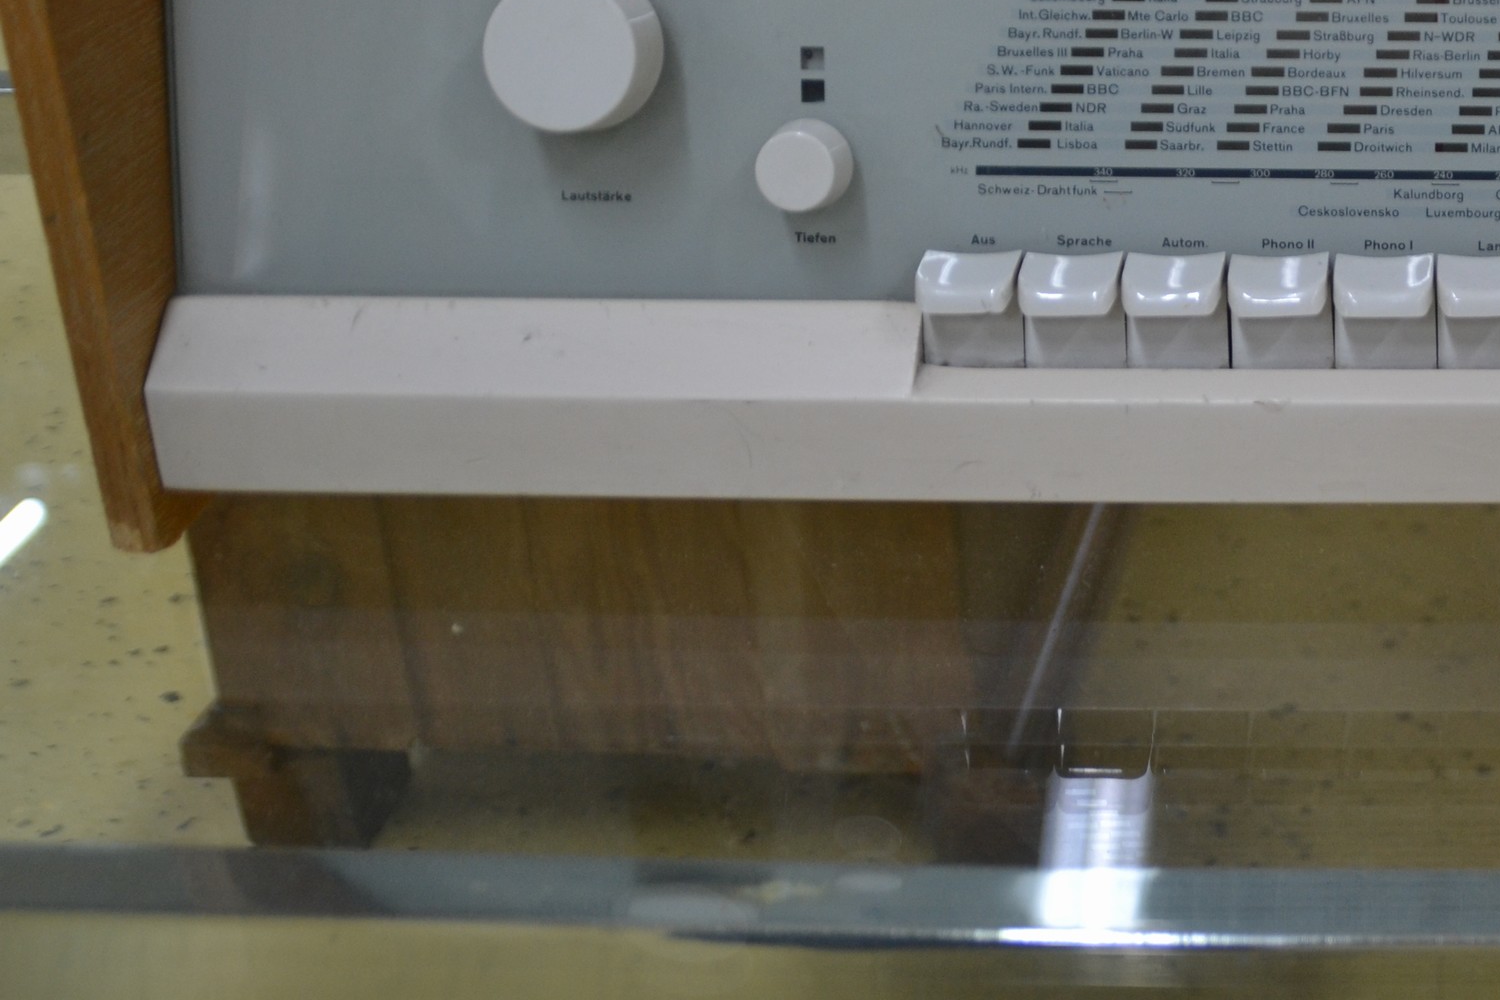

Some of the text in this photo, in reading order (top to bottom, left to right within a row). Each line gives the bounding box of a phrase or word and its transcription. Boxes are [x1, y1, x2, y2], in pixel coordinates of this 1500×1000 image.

[1127, 10, 1189, 22] Mte Carlo
[1231, 11, 1263, 22] BBC
[1331, 12, 1389, 24] Bruxelles
[1441, 13, 1497, 24] Toulouse
[1120, 29, 1174, 40] Berlin-W
[1216, 30, 1261, 43] Leipzig
[1424, 31, 1475, 43] N-WDR
[997, 46, 1054, 57] Bruxelles
[1107, 48, 1144, 59] Praha
[1211, 48, 1240, 59] Italia
[1412, 50, 1481, 61] Rias-Berlin
[1096, 66, 1150, 77] Vaticano
[1196, 66, 1246, 78] Bremen
[1287, 67, 1346, 78] Bordeaux
[1401, 68, 1463, 79] Hilversum
[975, 83, 1007, 94] Paris
[1087, 84, 1119, 95] BBC
[1187, 85, 1212, 96] Lille
[1282, 86, 1349, 97] BBC-BFN
[1075, 103, 1107, 113] NDR
[1177, 103, 1207, 114] Graz
[1269, 104, 1306, 115] Praha
[1380, 105, 1433, 116] Dresden
[953, 120, 1012, 131] Hannover
[1065, 121, 1094, 132] Italia
[1262, 123, 1305, 134] France
[1363, 124, 1395, 135] Paris
[1057, 139, 1098, 150] Lisboa
[1252, 141, 1293, 152] Stettin
[1354, 142, 1413, 153] Droitwich
[1094, 167, 1113, 176] 340
[1176, 168, 1195, 177] 320
[1314, 169, 1335, 179] 280
[1393, 189, 1464, 203] Kalundborg
[1298, 205, 1400, 217] Ceskoslovensko
[794, 231, 836, 243] Tiefen
[971, 234, 996, 246] Aus
[1057, 235, 1112, 248] Sprache
[1262, 238, 1314, 250] Phono II
[1364, 239, 1406, 251] Phono
